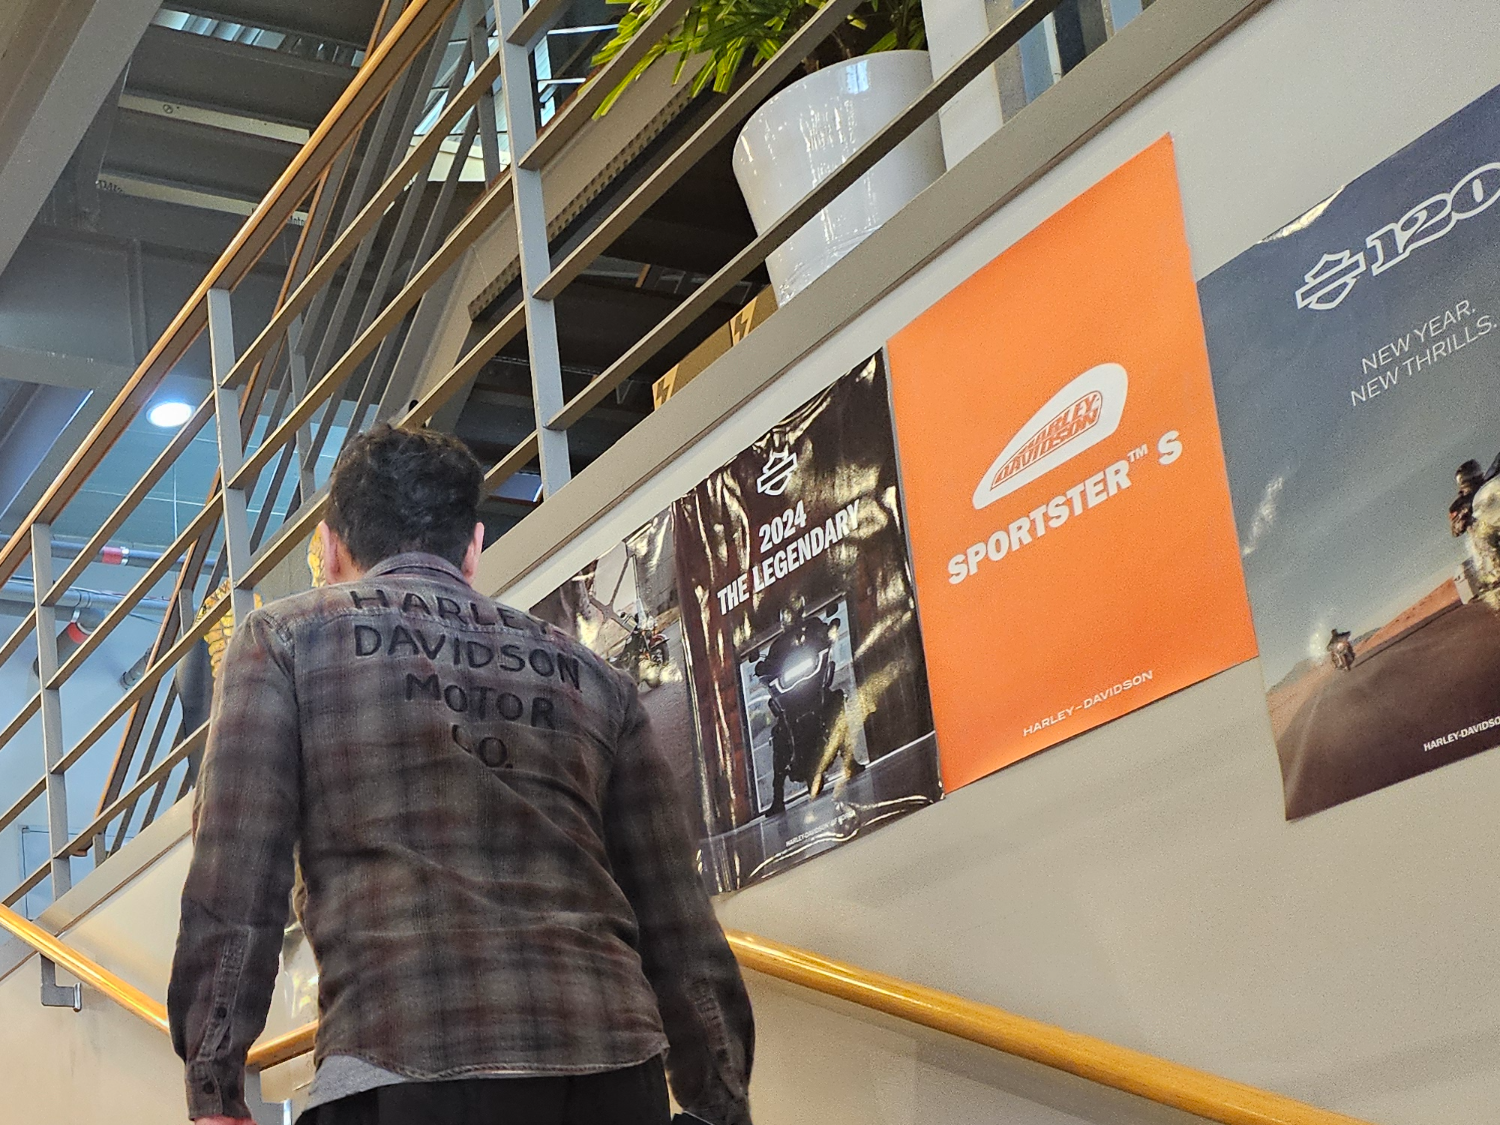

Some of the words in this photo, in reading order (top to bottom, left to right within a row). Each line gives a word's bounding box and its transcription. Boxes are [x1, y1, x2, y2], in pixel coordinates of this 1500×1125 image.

[1350, 367, 1400, 406] NEW
[1402, 315, 1497, 377] THRILLS.
[1361, 334, 1411, 374] NEW
[1414, 299, 1476, 343] YEAR.
[1157, 430, 1183, 465] S
[717, 573, 749, 616] THE
[752, 499, 860, 593] LEGENDARY
[759, 500, 807, 553] 2024
[353, 624, 582, 693] DAVIDSON
[405, 673, 555, 730] MOTOR
[1023, 670, 1153, 737] HARLEY-DAVIDSON
